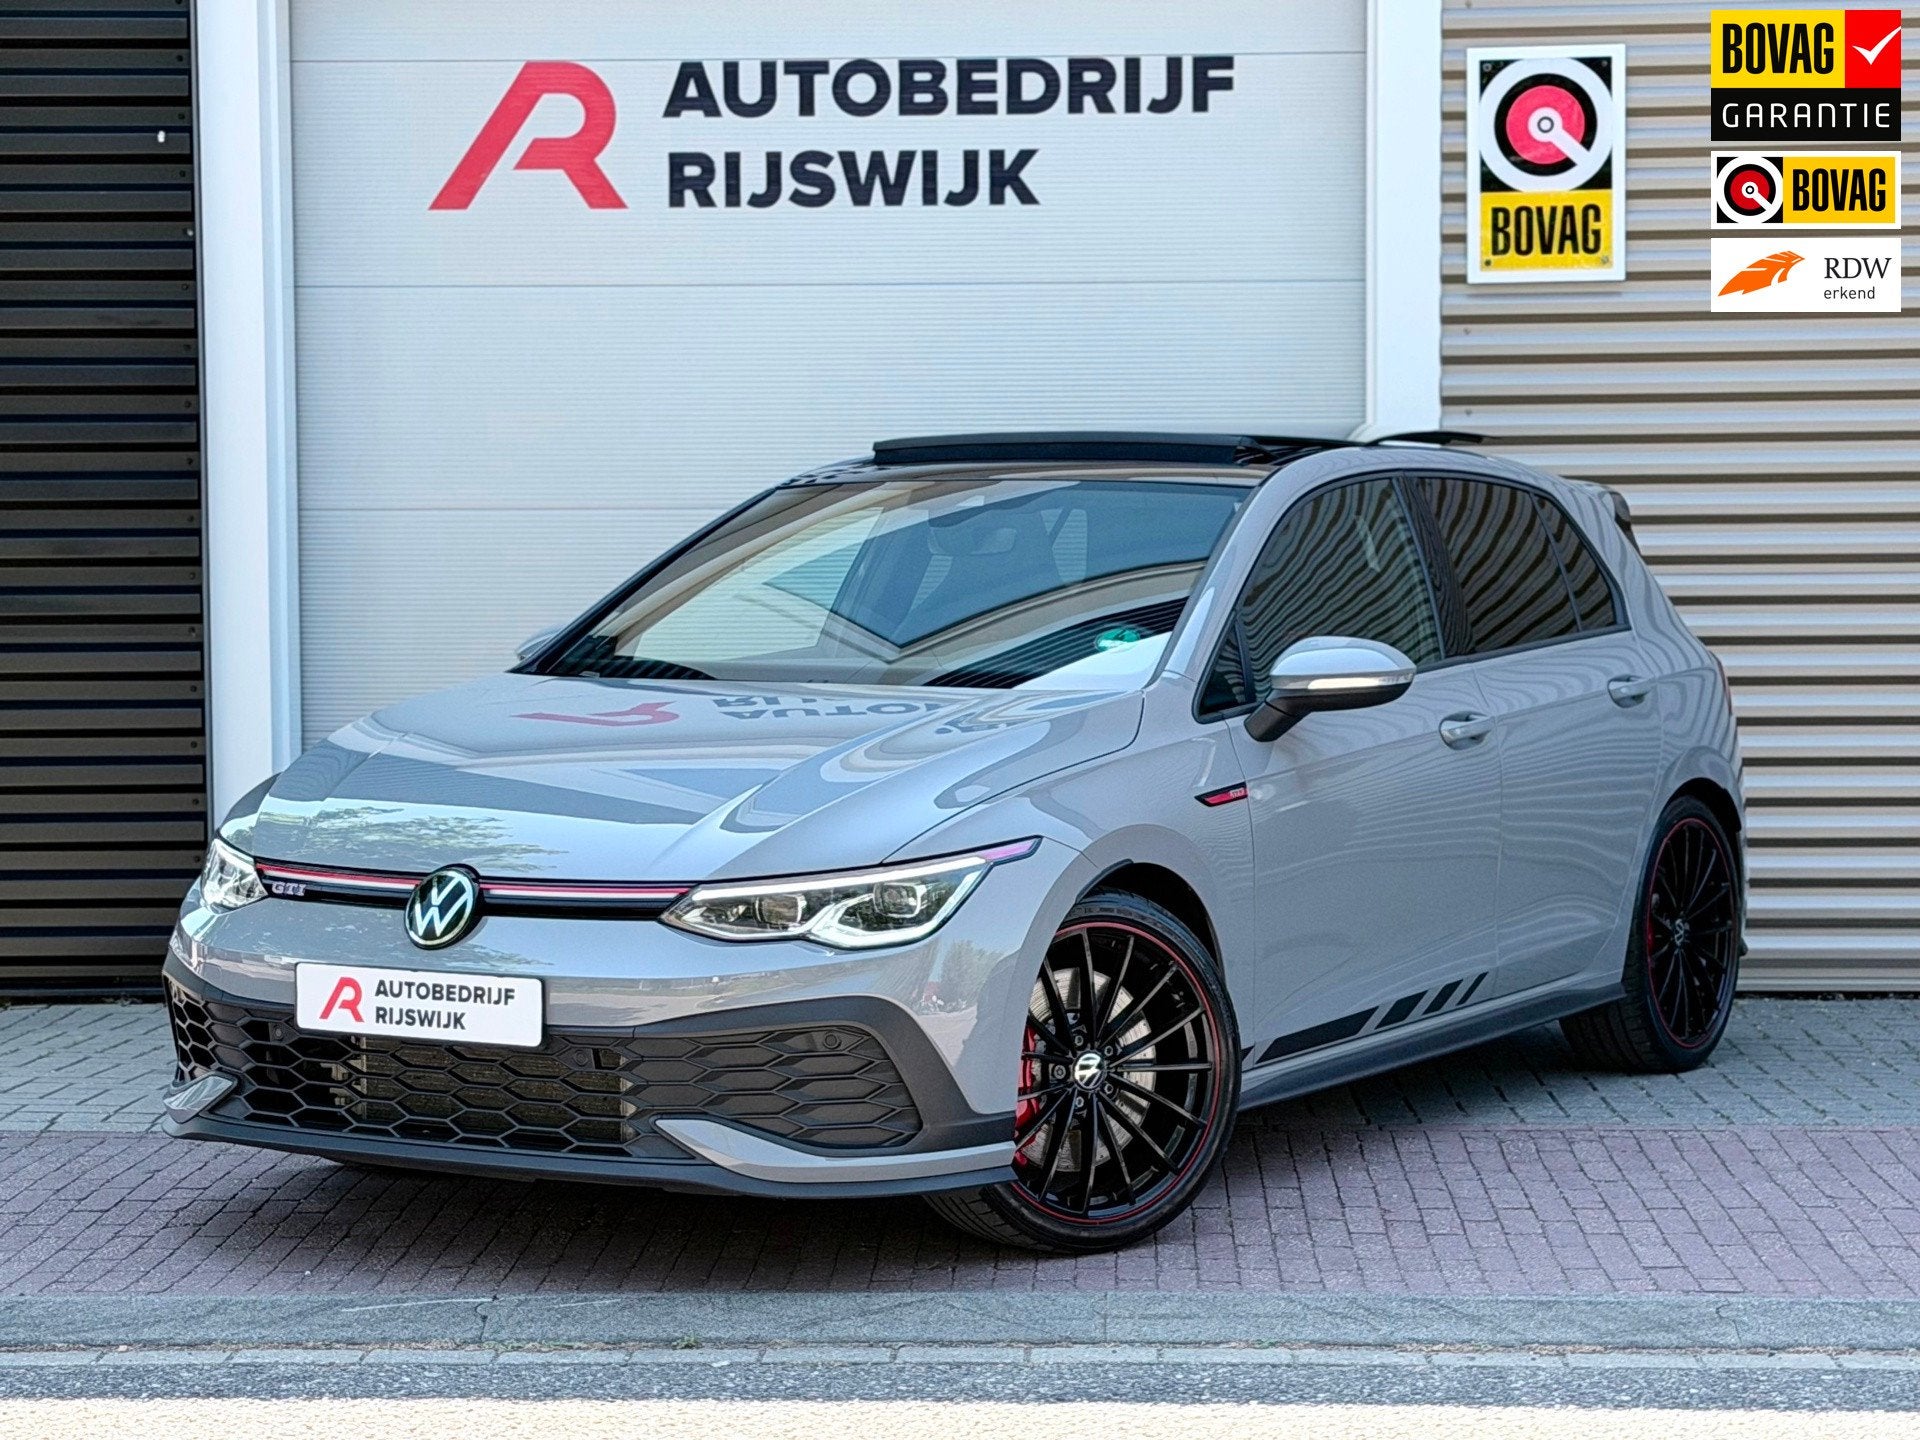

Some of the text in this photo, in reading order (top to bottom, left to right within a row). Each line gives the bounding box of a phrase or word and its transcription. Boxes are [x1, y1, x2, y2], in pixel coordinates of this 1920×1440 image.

[661, 55, 1235, 118] AUTOBEDRIJF
[668, 149, 1039, 209] RIJSWIJK
[1491, 203, 1601, 257] BOVAG
[271, 881, 306, 896] GTI
[375, 979, 515, 1006] AUTOBEDRIJF
[375, 1006, 466, 1030] RIJSWIJK
